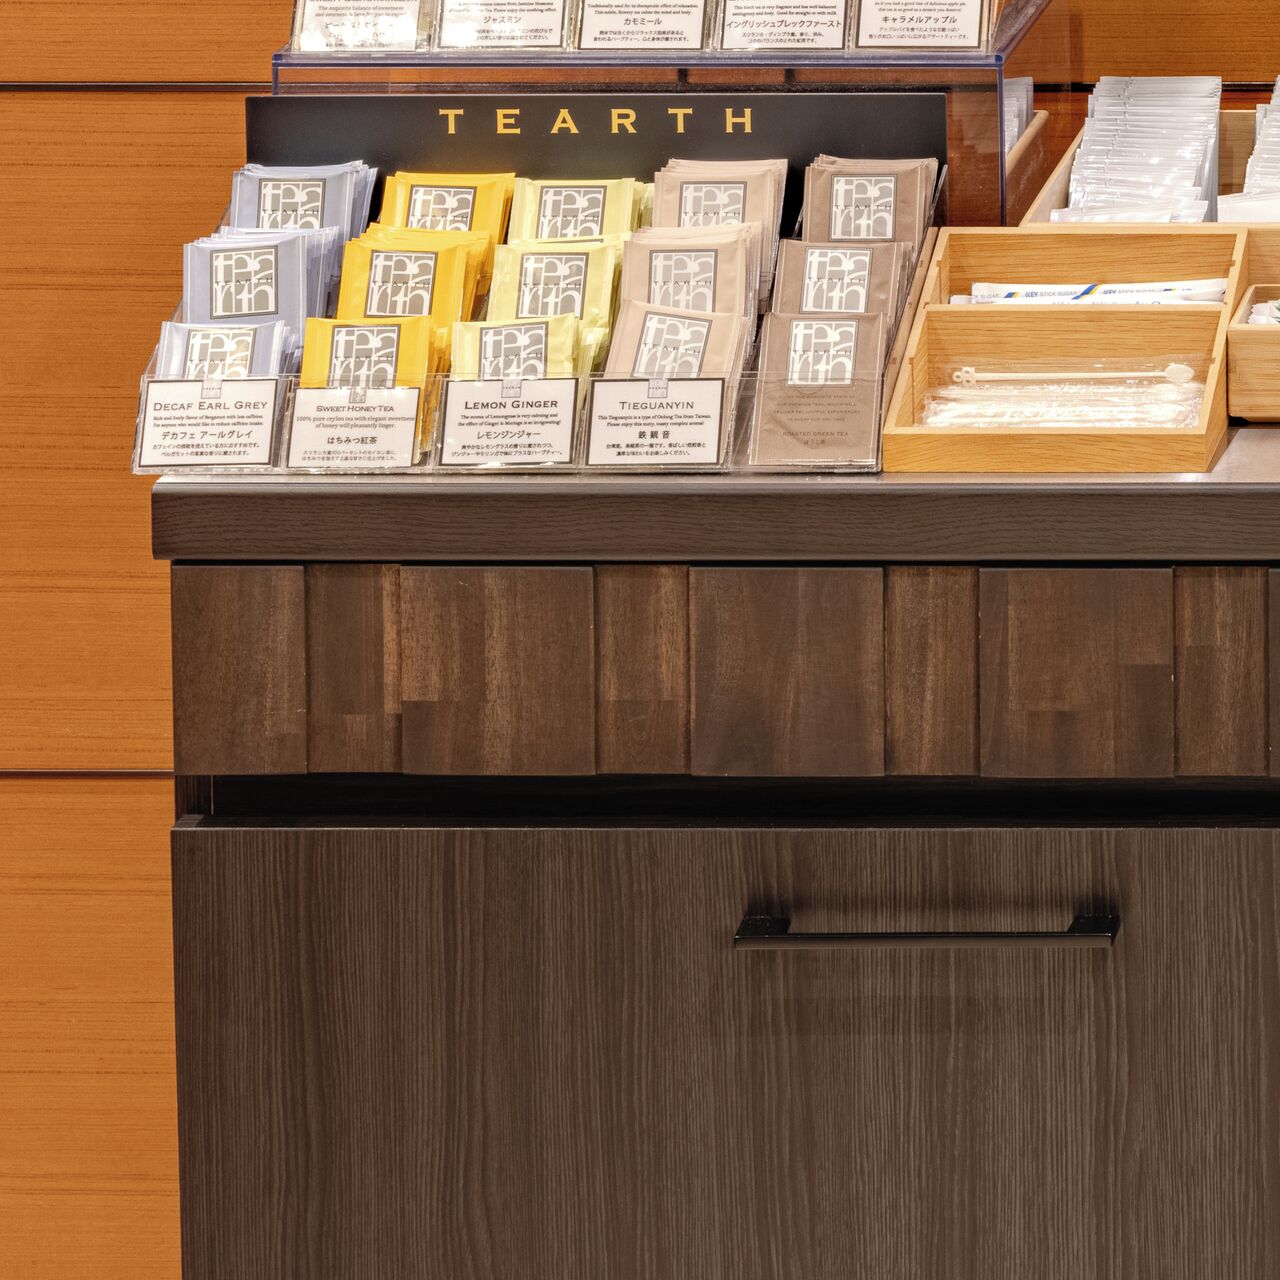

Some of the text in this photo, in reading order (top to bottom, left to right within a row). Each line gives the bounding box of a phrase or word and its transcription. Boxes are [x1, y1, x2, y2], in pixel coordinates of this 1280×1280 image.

[623, 17, 662, 25] カモミール
[882, 15, 957, 24] キャラメルアップル
[438, 108, 752, 134] TEARTH
[153, 400, 268, 411] DECAF EARL GREY
[465, 400, 558, 410] LEMON GINGER
[619, 401, 694, 410] TIEGUANYIN
[161, 430, 253, 440] デカフェ アールグレイ
[477, 430, 541, 439] レモンジンジャー
[327, 436, 377, 445] はちみつ紅茶
